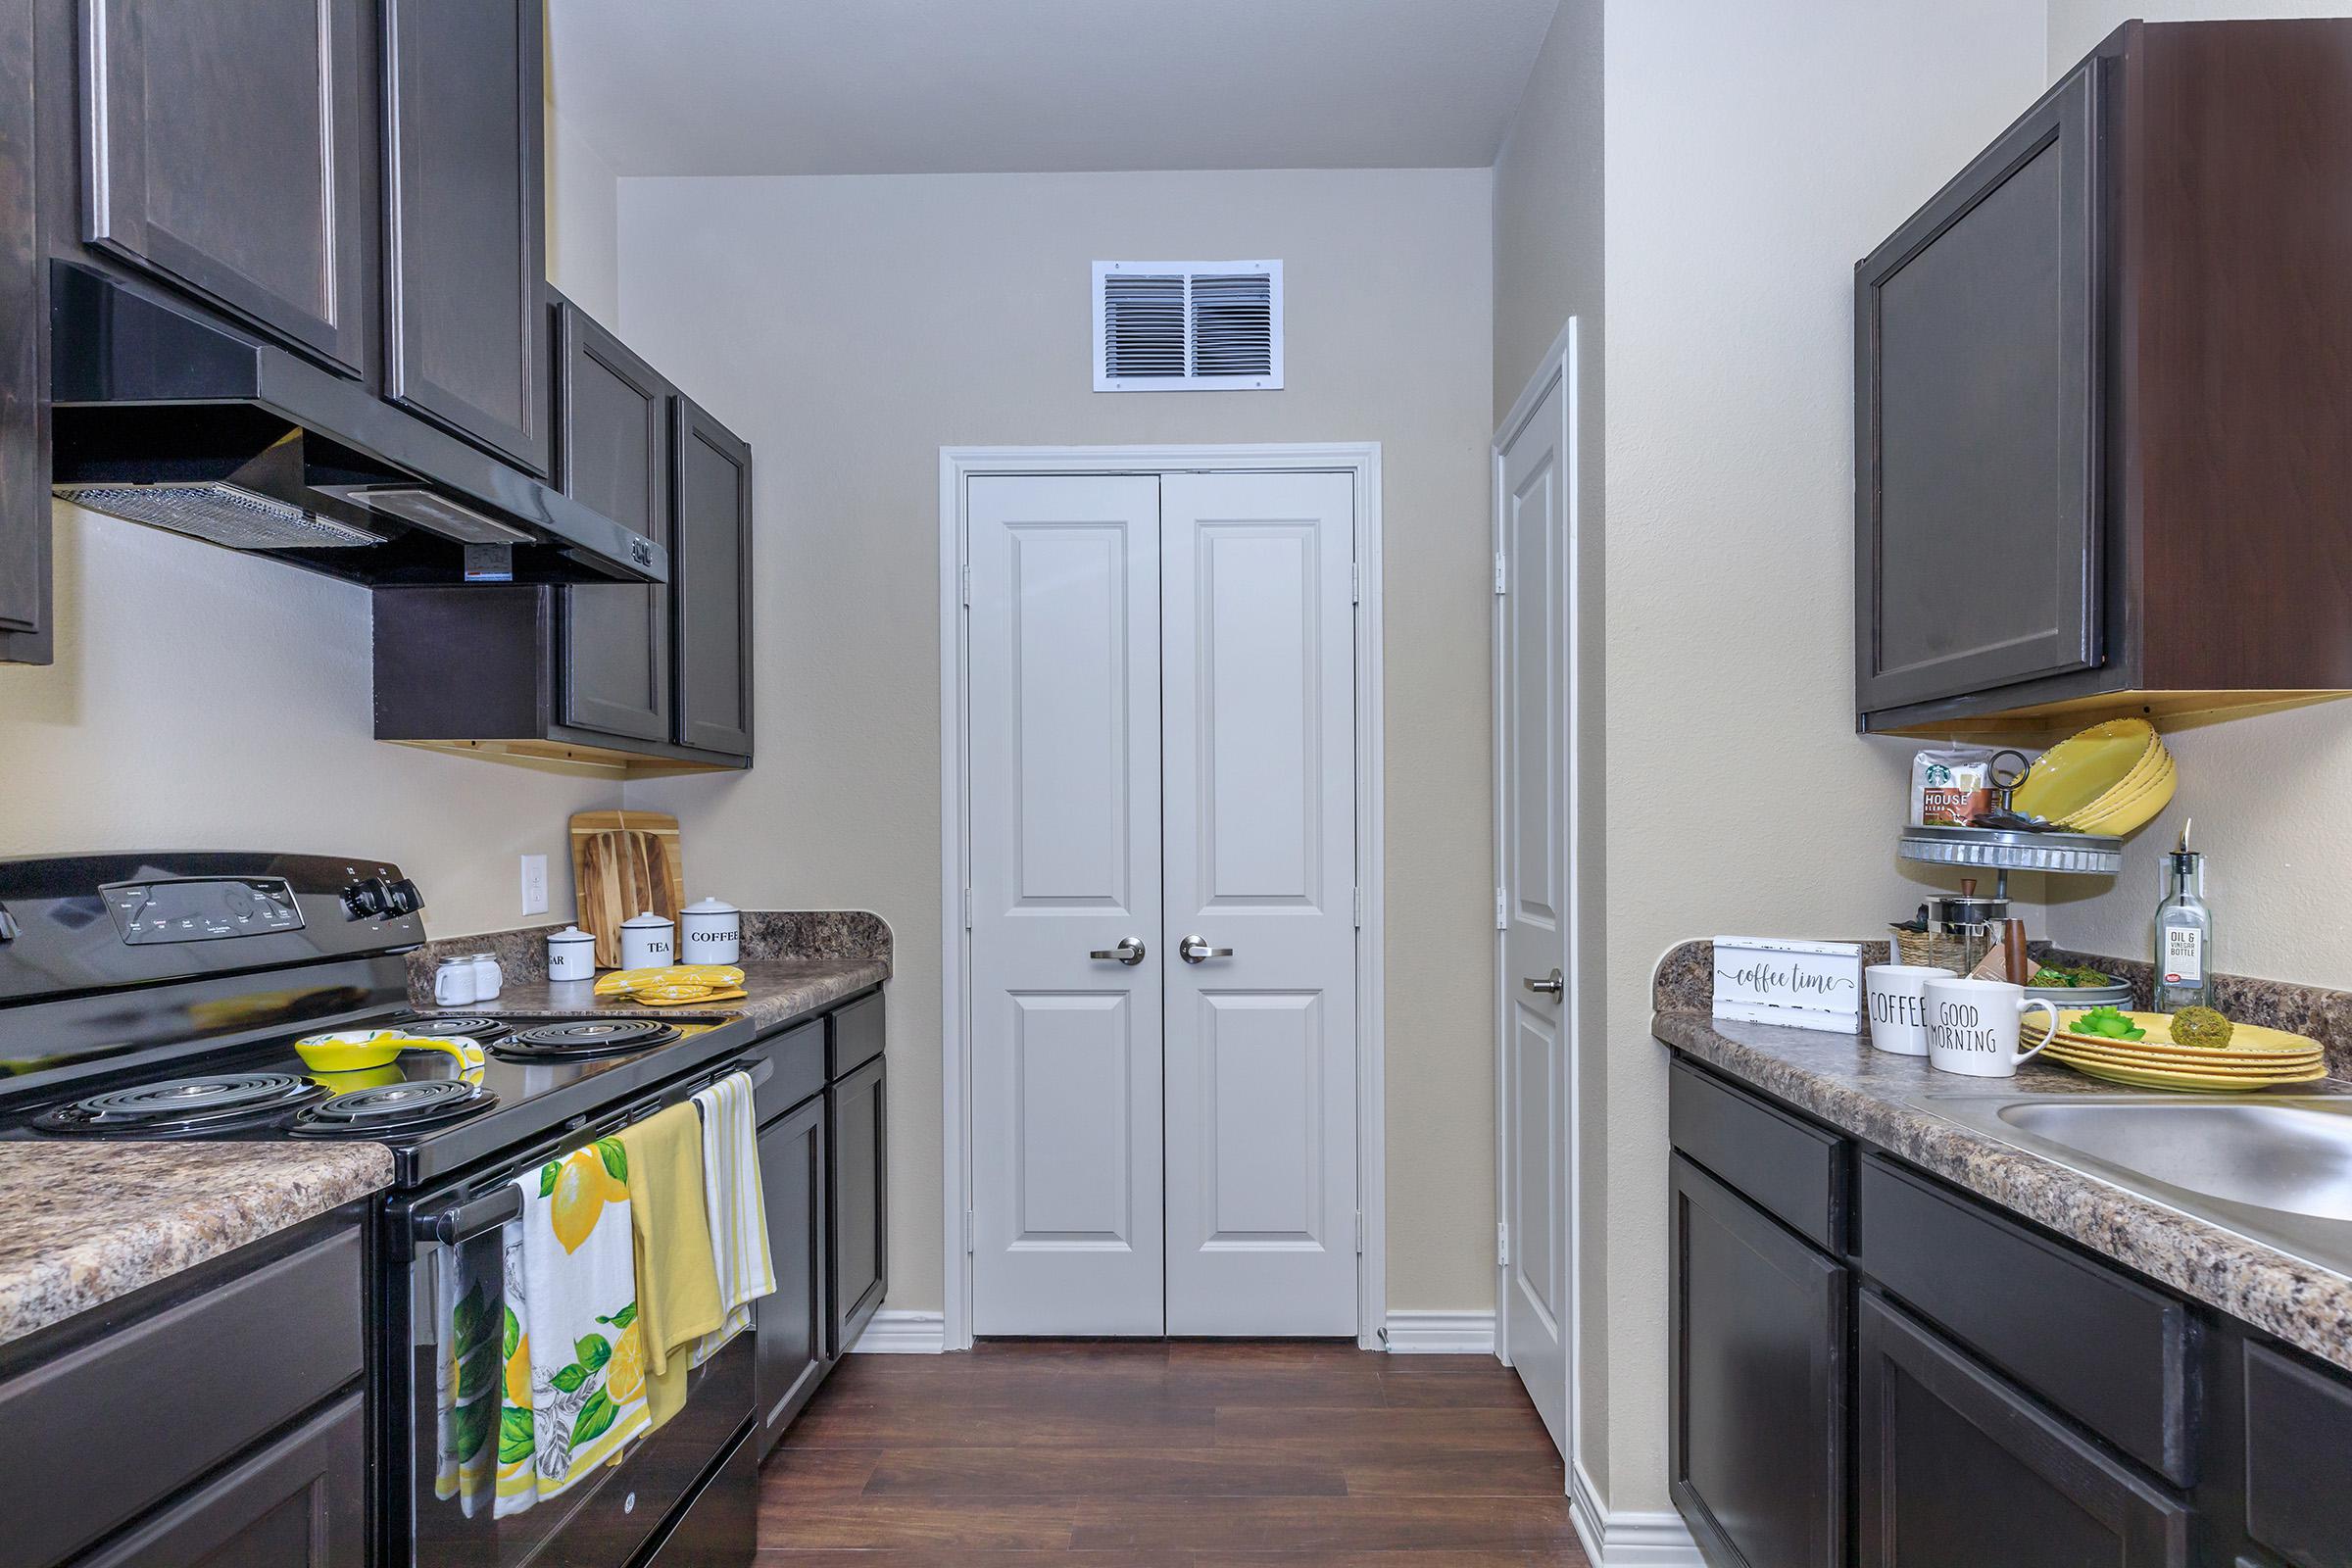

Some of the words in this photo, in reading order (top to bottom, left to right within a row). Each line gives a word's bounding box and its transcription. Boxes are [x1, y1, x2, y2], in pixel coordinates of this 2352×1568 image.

[1925, 795, 1967, 806] HOUSE
[691, 931, 739, 942] COFFEE
[2171, 931, 2184, 942] OIL
[2188, 933, 2194, 943] &
[647, 942, 670, 953] TEA
[2171, 948, 2195, 956] BOTTLE
[1717, 962, 1788, 994] coffee
[1791, 963, 1855, 995] time
[1871, 992, 1928, 1027] COFFEE
[1939, 1002, 1979, 1028] GOOD
[1931, 1024, 1996, 1054] MORNING
